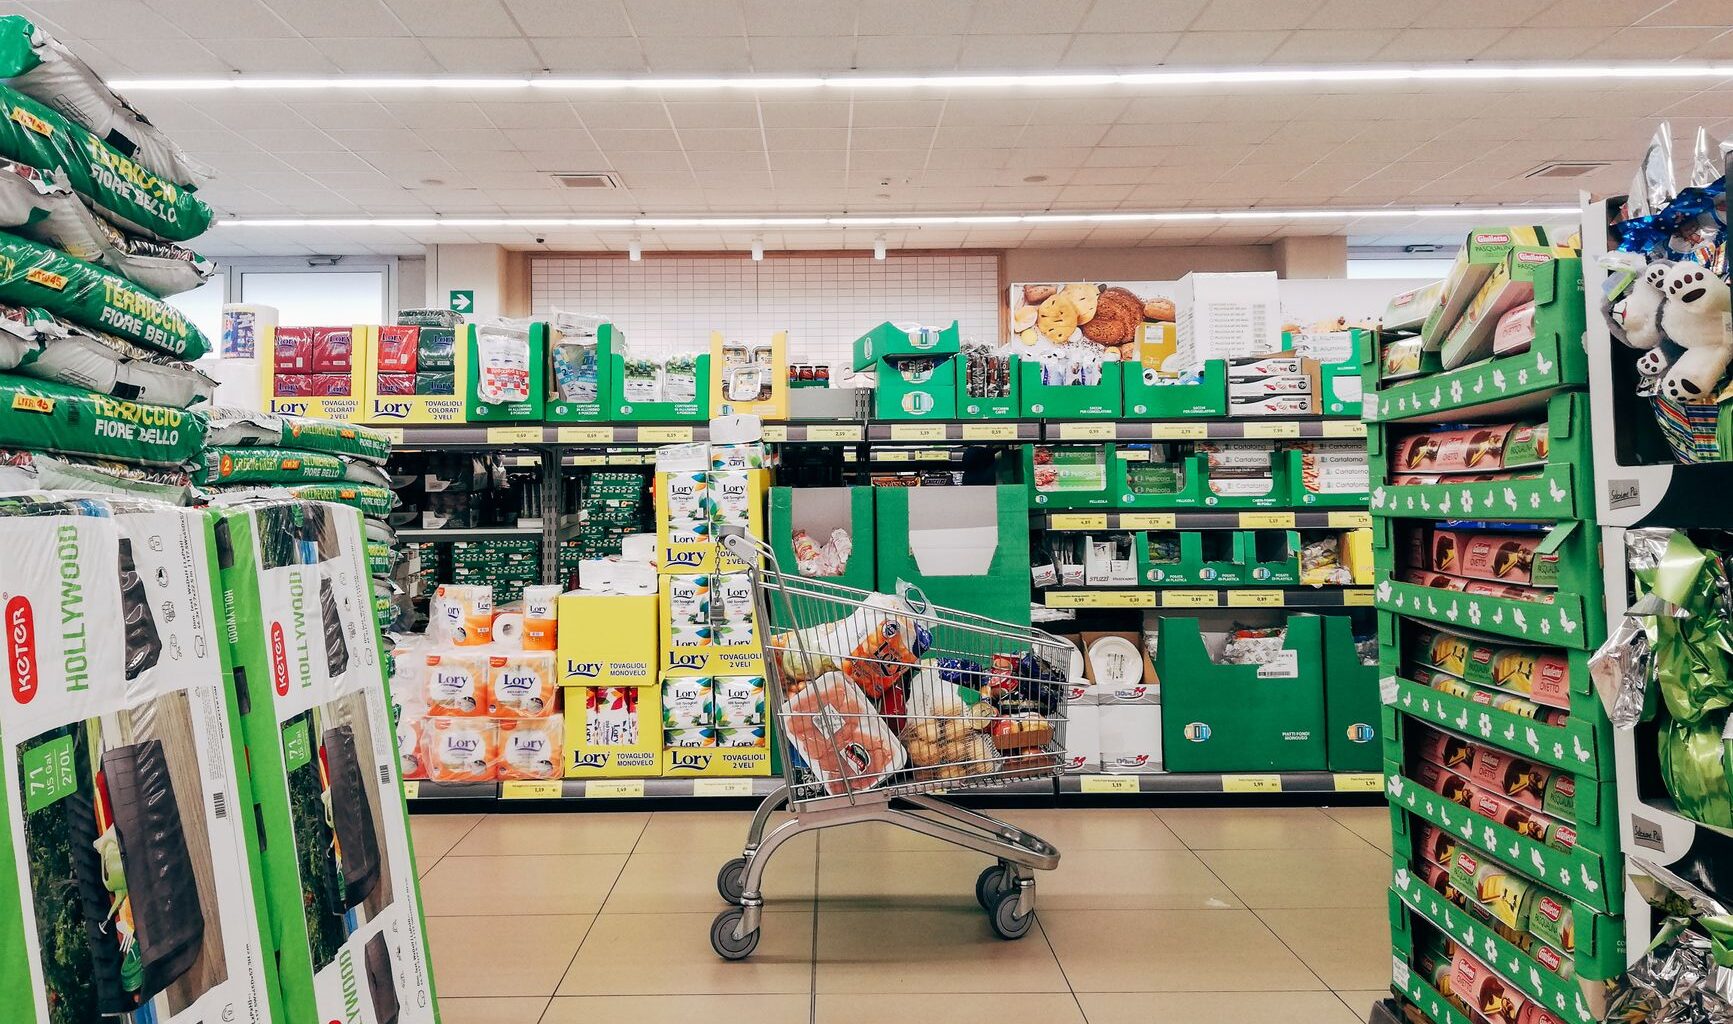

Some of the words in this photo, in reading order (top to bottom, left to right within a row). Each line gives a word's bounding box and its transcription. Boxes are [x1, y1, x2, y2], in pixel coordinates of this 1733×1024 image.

[91, 163, 130, 198] FIORE
[132, 192, 177, 223] BELLO
[103, 278, 186, 338] TERRICCIO
[100, 307, 142, 336] FIORE
[145, 326, 186, 355] BELLO
[383, 333, 402, 341] Lory
[329, 335, 350, 343] Lory
[433, 335, 454, 343] Lory
[279, 383, 298, 391] Lory
[328, 384, 348, 392] Lory
[431, 382, 453, 390] Lory
[37, 398, 48, 410] 45
[88, 394, 181, 427] TERRICCIO
[270, 400, 308, 417] Lory
[374, 400, 412, 417] Lory
[95, 418, 134, 439] FIORE
[139, 427, 179, 446] BELLO
[224, 460, 229, 471] 2
[303, 468, 321, 476] FIORE
[672, 485, 693, 495] Lory
[723, 484, 745, 495] Lory
[673, 535, 695, 543] Lory
[667, 547, 706, 567] Lory
[673, 587, 695, 599] Lory
[727, 588, 749, 598] Lory
[58, 524, 89, 692] HOLLYWOOD
[530, 605, 547, 614] Lory
[224, 589, 239, 645] HOLLYWOOD
[289, 571, 312, 689] HOLLYWOOD
[670, 651, 709, 666] Lory
[568, 660, 603, 675] Lory
[438, 673, 468, 688] Lory
[503, 674, 535, 689] Lory
[676, 689, 697, 700] Lory
[728, 689, 750, 700] Lory
[1540, 683, 1560, 693] OVETTO
[289, 740, 298, 760] 71
[448, 737, 479, 751] Lory
[514, 737, 545, 751] Lory
[61, 743, 72, 786] 270L
[575, 751, 610, 765] Lory
[672, 751, 712, 766] Lory
[44, 753, 55, 779] Gal
[1479, 767, 1496, 779] OVETTO
[30, 766, 44, 797] 71
[47, 779, 56, 797] US
[1457, 976, 1473, 993] OVETTO
